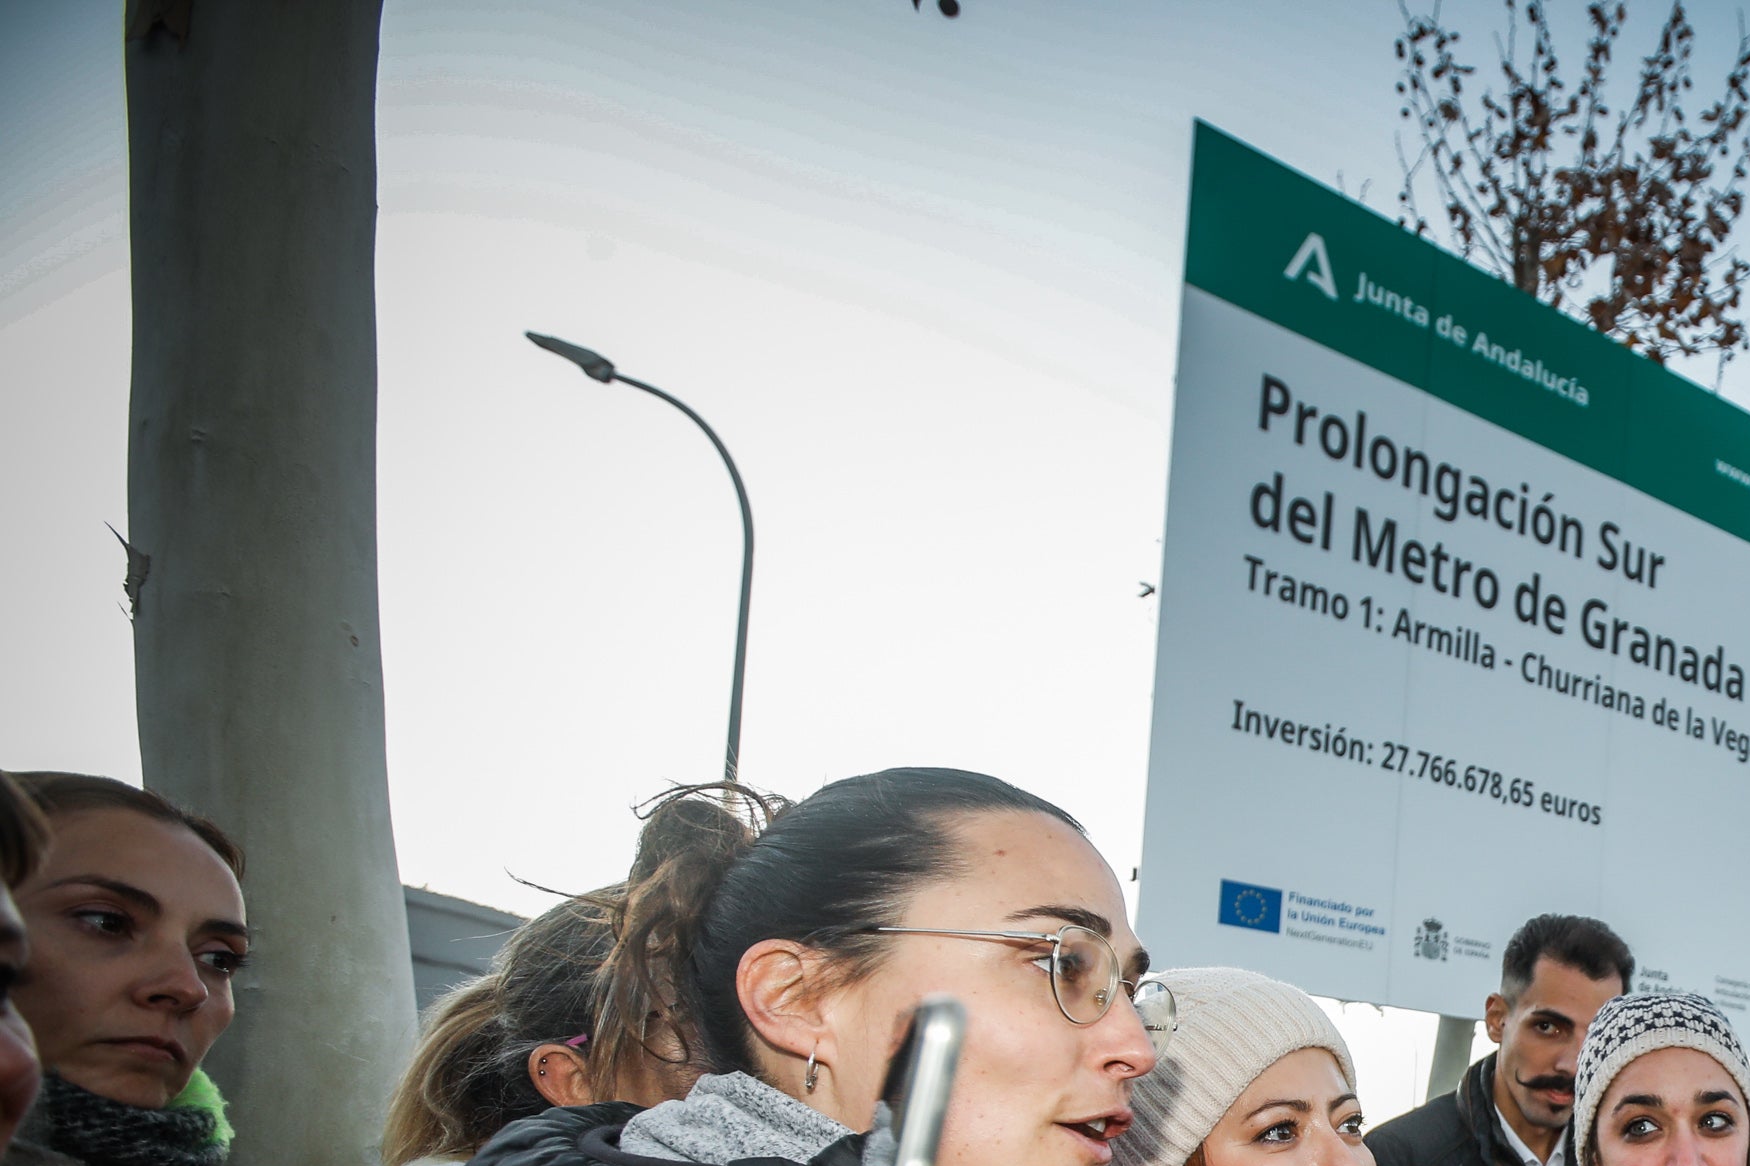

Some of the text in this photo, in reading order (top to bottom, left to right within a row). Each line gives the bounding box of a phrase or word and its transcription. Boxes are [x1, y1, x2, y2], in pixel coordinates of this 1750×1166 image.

[1353, 271, 1590, 407] Junta de Andalucía
[1258, 373, 1666, 590] Prolongación Sur
[1244, 554, 1349, 620] Tramo
[1361, 596, 1384, 634] 1:
[1392, 607, 1495, 670] Armilla
[1520, 651, 1645, 719] Churriana
[1652, 697, 1680, 731] de
[1685, 706, 1705, 741] la
[1249, 472, 1746, 702] del Metro de Granada
[1231, 699, 1602, 826] Inversión: 27.766.678,65 euros
[1287, 909, 1386, 936] la Unión Europea
[1288, 890, 1375, 918] Financiado por
